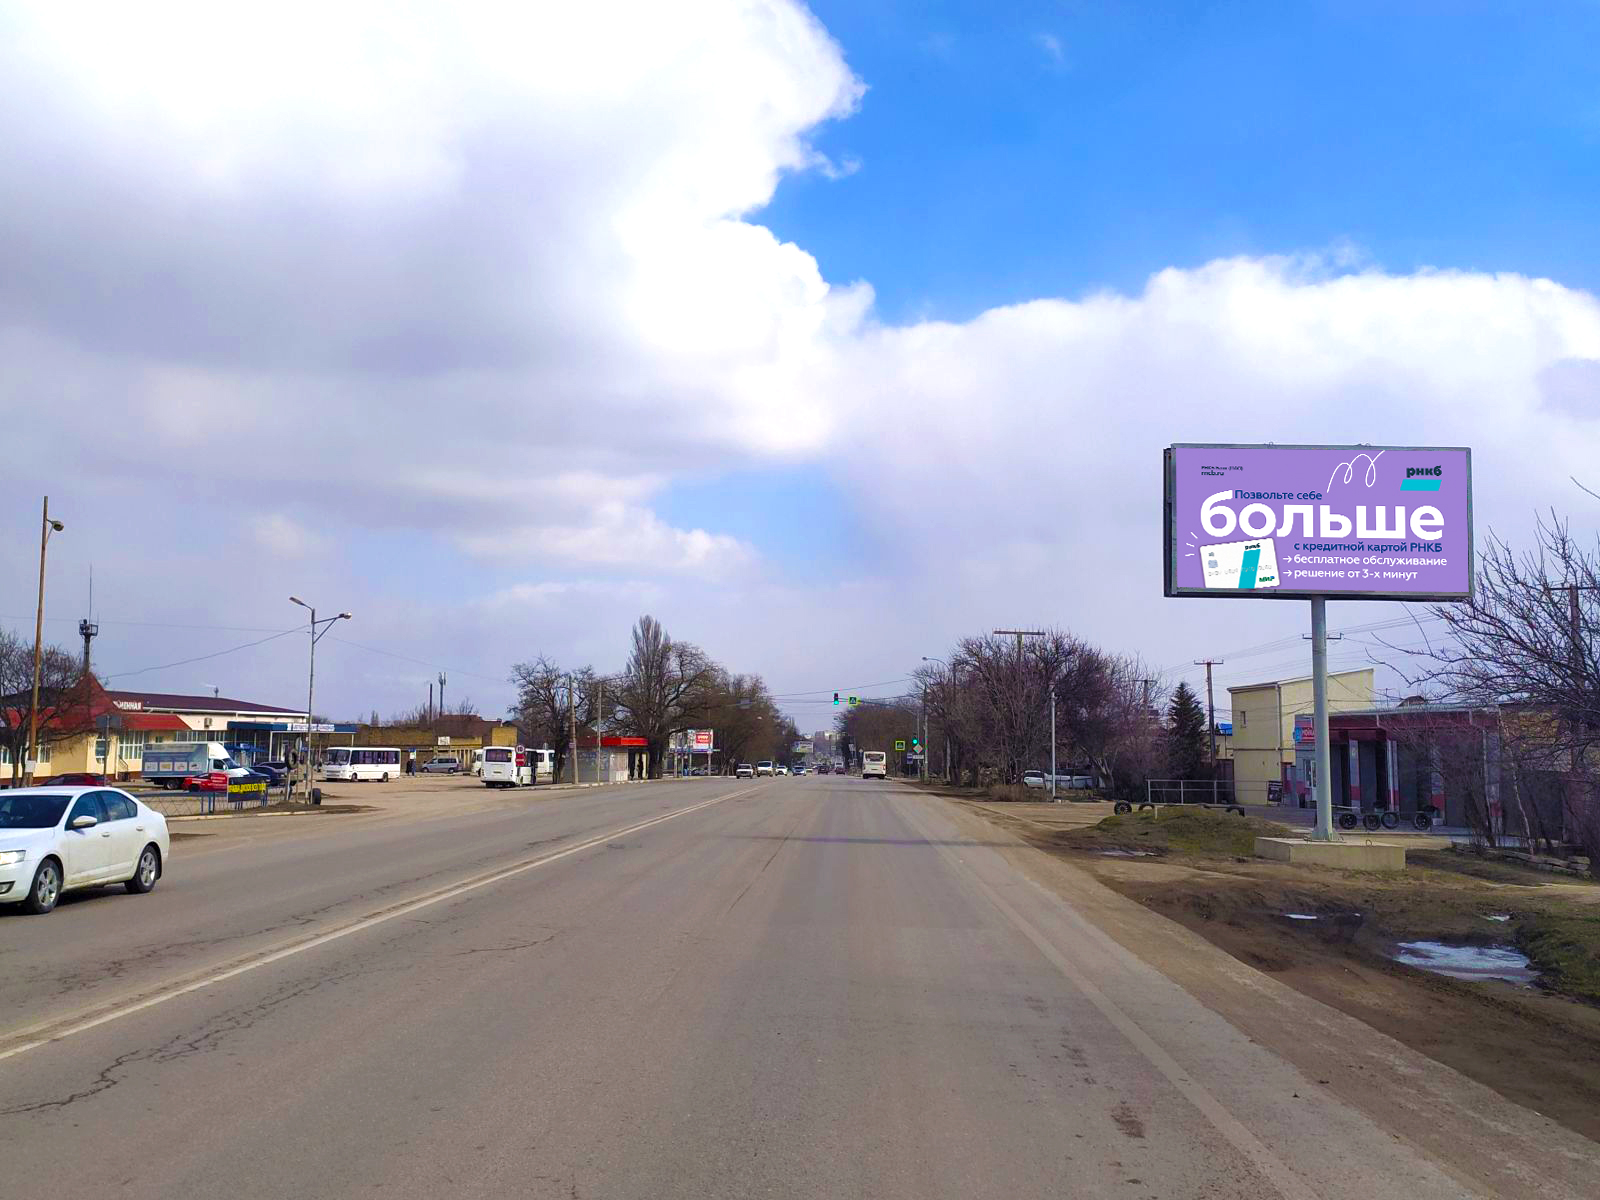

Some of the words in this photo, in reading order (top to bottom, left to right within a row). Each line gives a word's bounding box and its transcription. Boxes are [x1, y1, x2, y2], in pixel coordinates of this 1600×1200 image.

[1406, 465, 1442, 478] рнкб
[1235, 490, 1293, 500] Позвольте
[1297, 491, 1322, 500] себе
[1201, 489, 1444, 541] больше
[1303, 541, 1364, 552] кредитной
[1368, 542, 1407, 553] картой
[1410, 543, 1442, 552] РНКБ
[1294, 554, 1360, 564] бесплатное
[1363, 556, 1447, 567] обслуживание
[1294, 569, 1344, 579] решение
[1362, 569, 1380, 578] 3-х
[1384, 572, 1417, 580] минут
